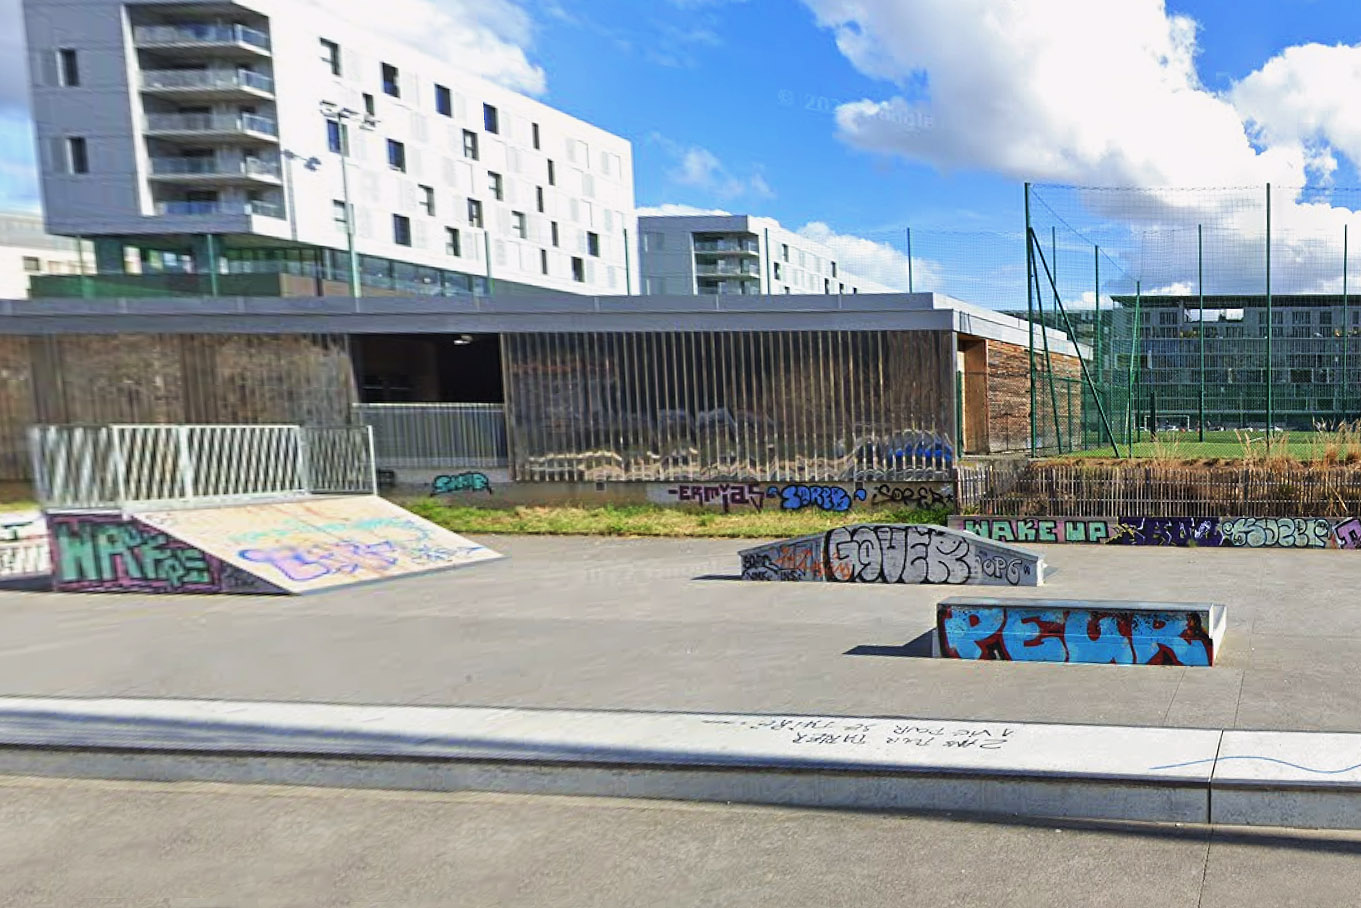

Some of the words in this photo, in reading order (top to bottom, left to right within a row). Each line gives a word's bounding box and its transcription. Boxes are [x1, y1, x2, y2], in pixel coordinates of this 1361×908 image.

[964, 519, 1057, 543] WAKE
[1063, 519, 1109, 543] UP
[938, 605, 1212, 666] PEUR
